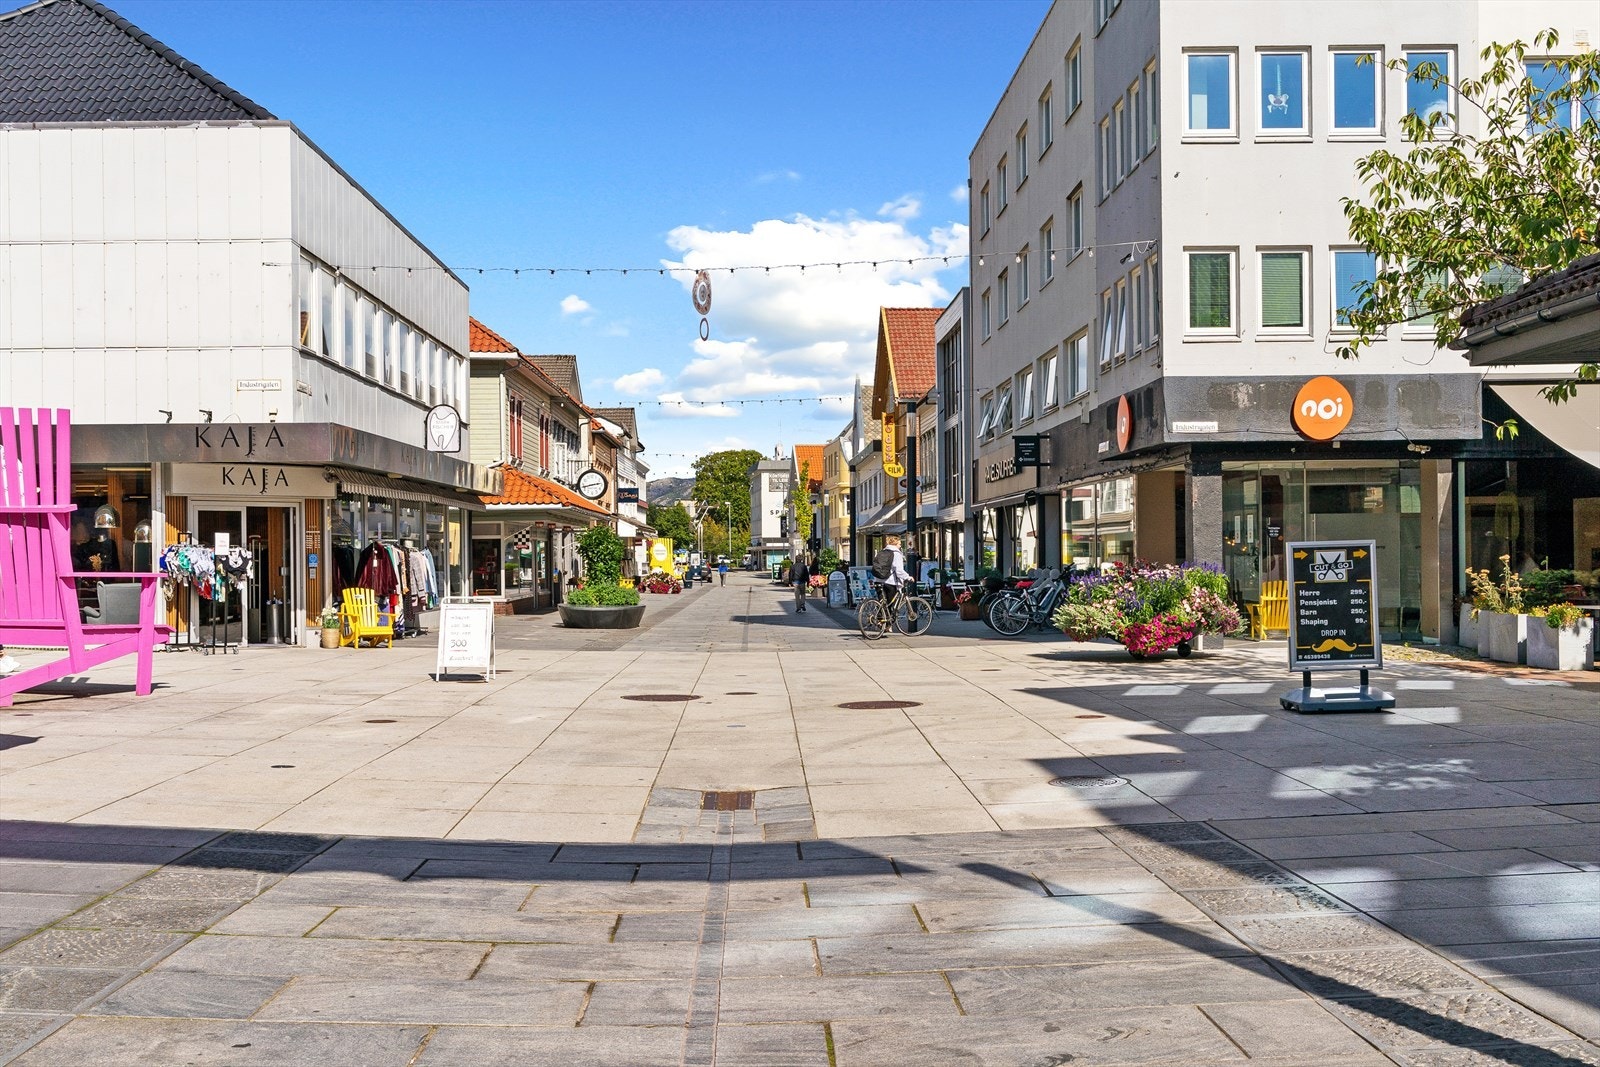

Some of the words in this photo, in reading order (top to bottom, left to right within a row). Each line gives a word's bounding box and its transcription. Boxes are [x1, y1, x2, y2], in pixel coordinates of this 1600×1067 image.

[1301, 397, 1343, 420] noi
[195, 425, 285, 457] KAJA
[222, 466, 289, 494] KAJA
[1314, 563, 1329, 571] CUT
[1300, 599, 1338, 607] Pensjonist
[1320, 629, 1337, 637] DROP
